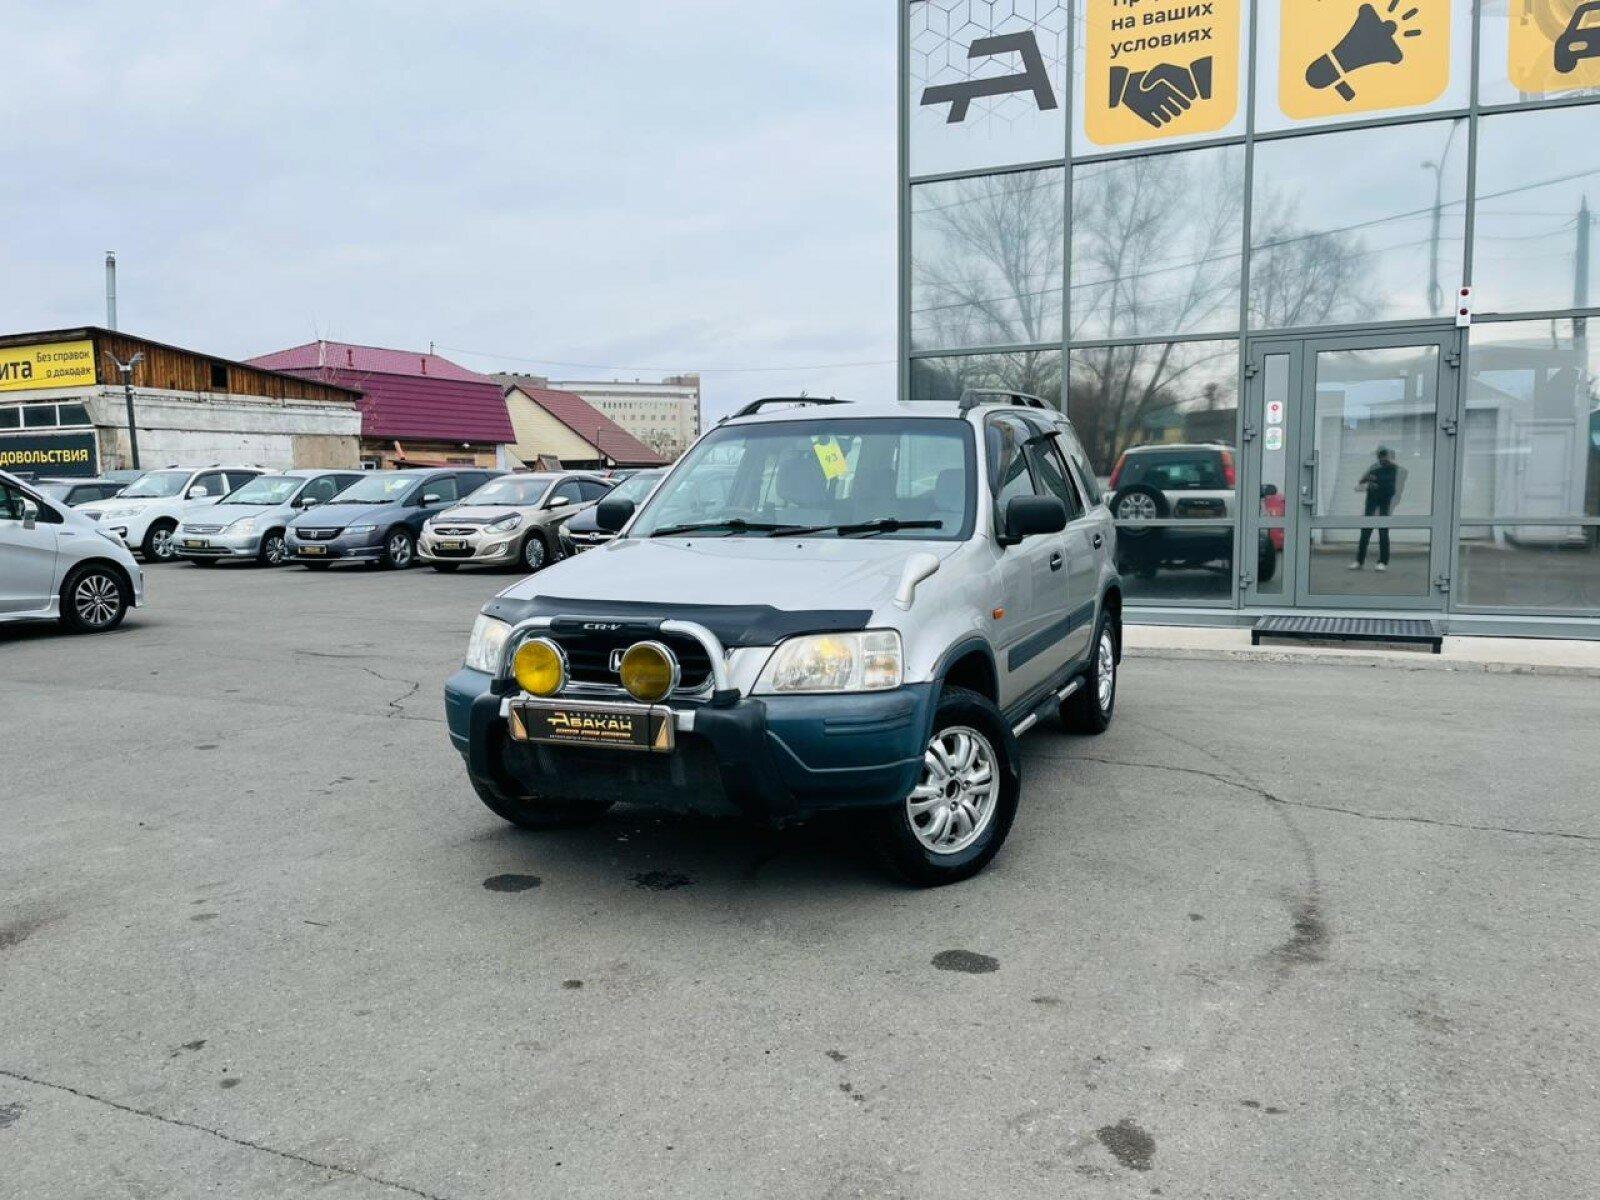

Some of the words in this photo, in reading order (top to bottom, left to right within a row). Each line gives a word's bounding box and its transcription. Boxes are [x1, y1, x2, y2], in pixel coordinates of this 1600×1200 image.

[1111, 15, 1136, 31] на
[1142, 2, 1214, 26] ваших
[1110, 26, 1213, 60] условиях
[37, 352, 51, 362] Без
[53, 350, 90, 362] справок
[53, 366, 91, 379] доходах
